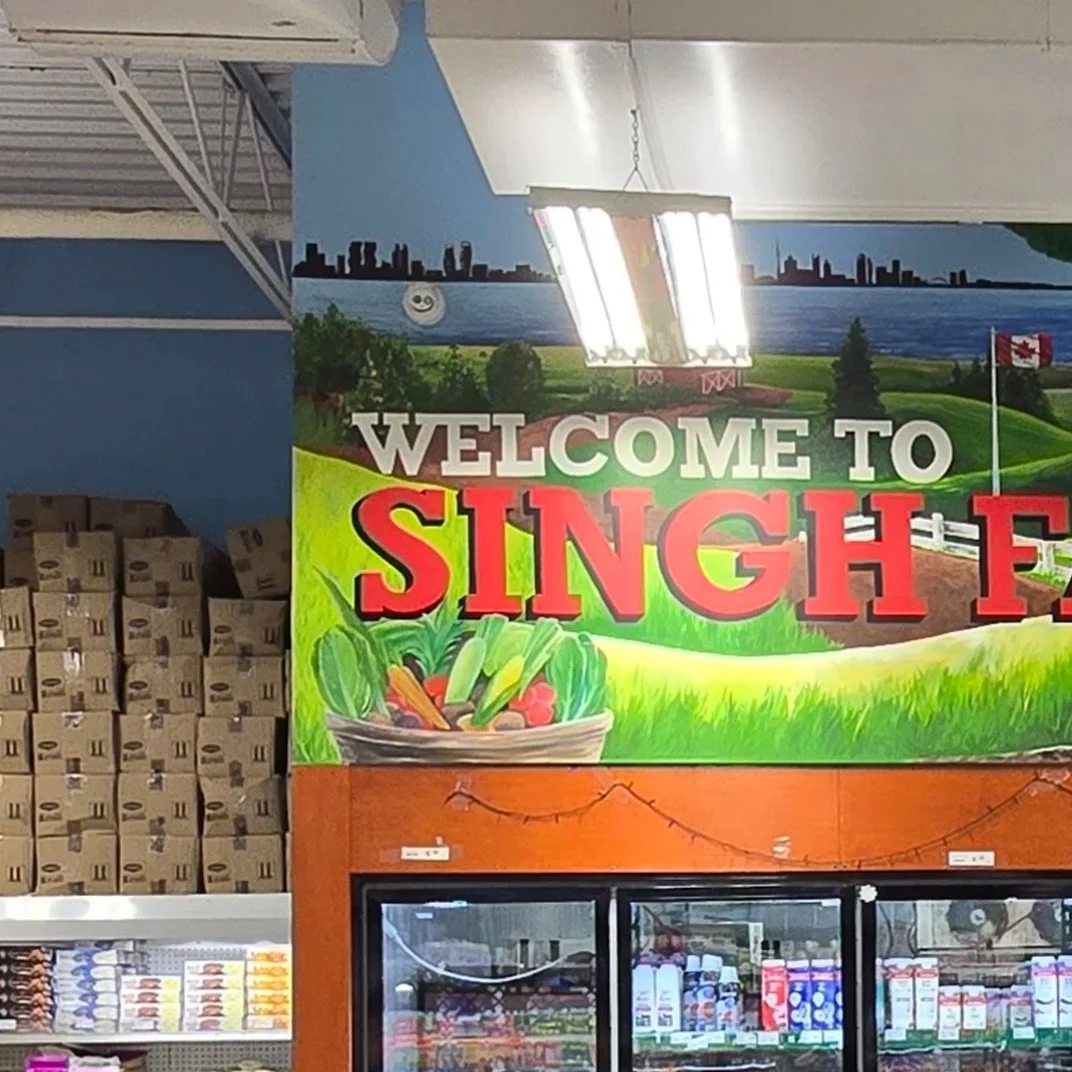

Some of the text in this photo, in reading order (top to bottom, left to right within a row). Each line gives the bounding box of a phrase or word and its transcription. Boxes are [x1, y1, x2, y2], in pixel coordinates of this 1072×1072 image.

[352, 412, 954, 484] WELCOME TO
[353, 485, 928, 622] SINGH
